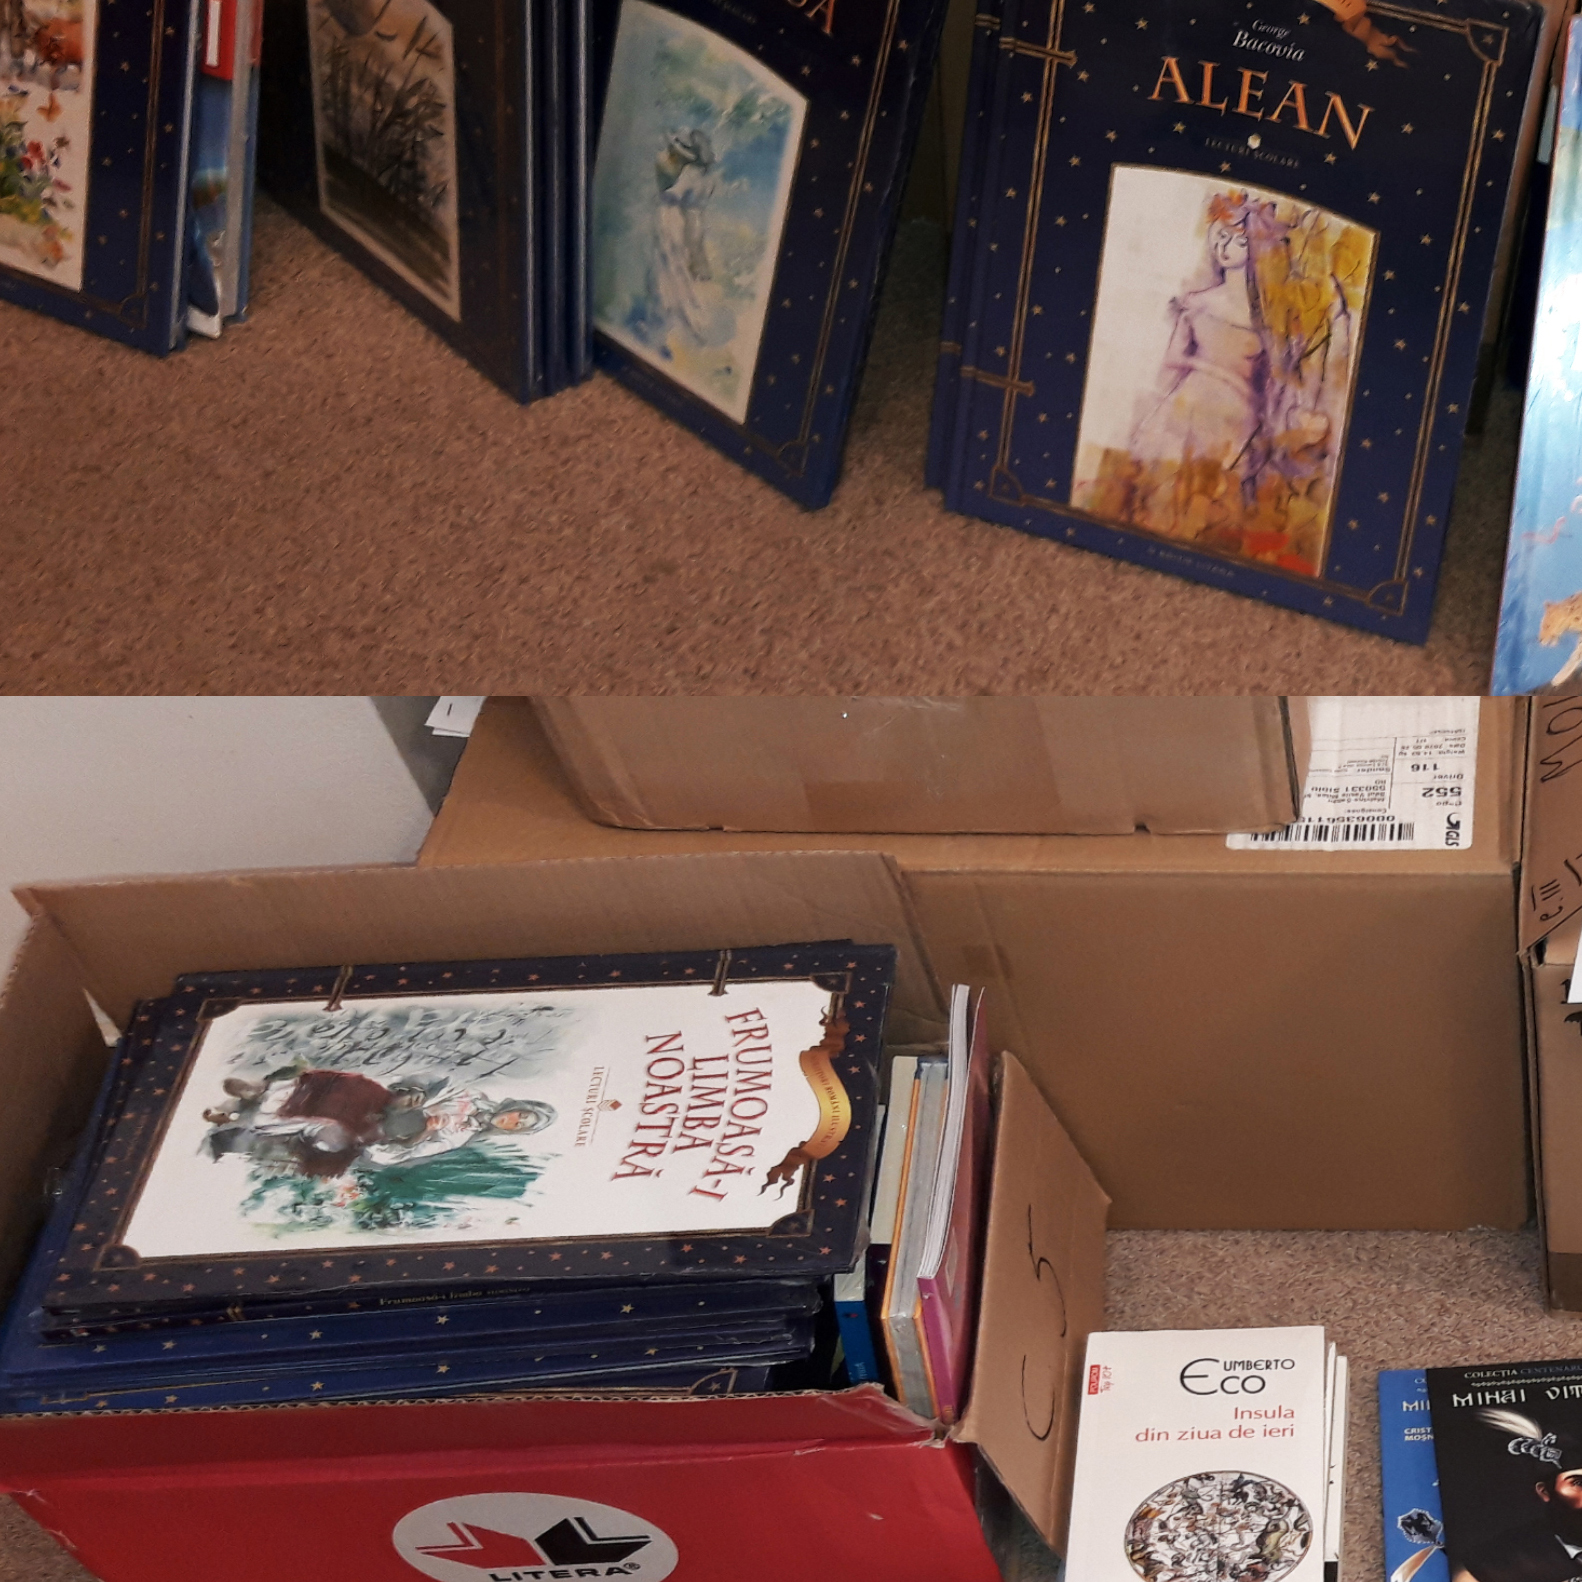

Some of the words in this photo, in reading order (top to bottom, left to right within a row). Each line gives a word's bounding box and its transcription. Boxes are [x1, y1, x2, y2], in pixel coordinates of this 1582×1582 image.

[1232, 29, 1305, 62] Bacovia
[1148, 56, 1375, 150] ALEAN
[1410, 763, 1441, 773] 116
[1422, 787, 1462, 798] 552
[1445, 829, 1459, 846] GLS
[585, 1065, 605, 1104] LECTURI
[609, 1030, 685, 1182] NOASTRĂ
[672, 1053, 729, 1155] LIMBA
[688, 1007, 773, 1202] FRUMOASĂ-I
[1223, 1358, 1295, 1372] UMBERTO
[1464, 1369, 1518, 1379] COLECȚIA
[1452, 1388, 1526, 1408] MIHAI
[1234, 1404, 1295, 1420] Insula
[1135, 1427, 1170, 1443] din
[1177, 1426, 1222, 1441] ziua
[1228, 1424, 1255, 1439] de
[1262, 1423, 1295, 1438] ieri
